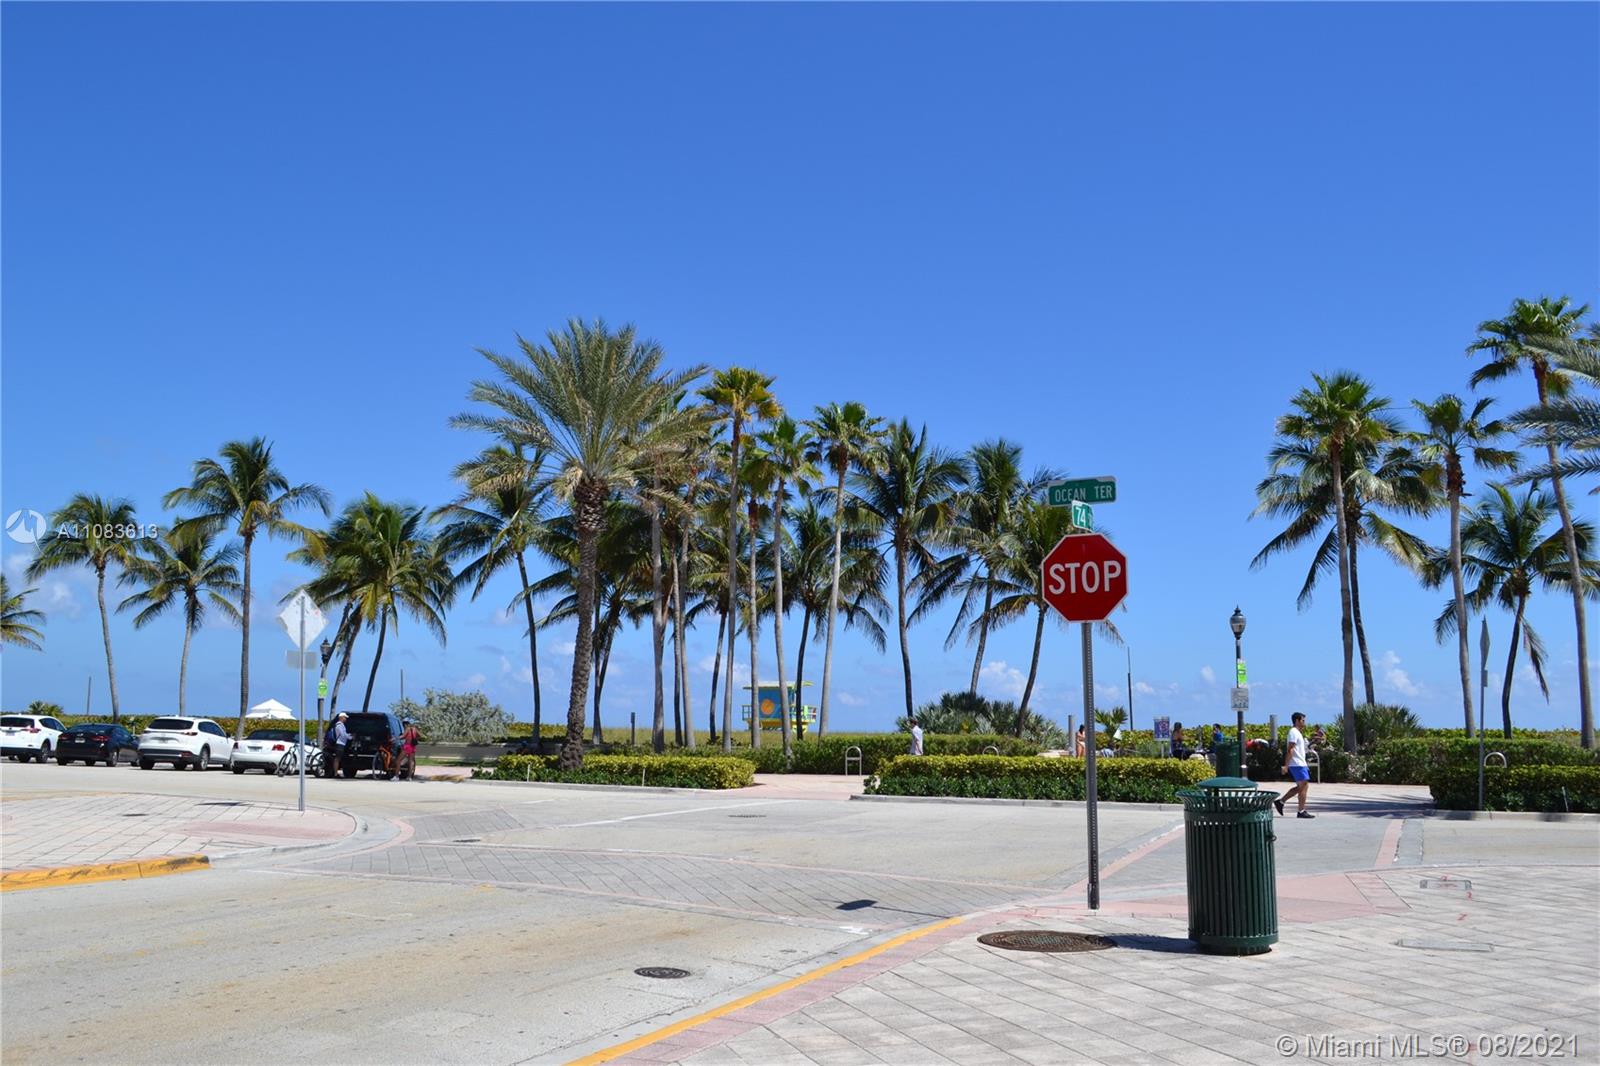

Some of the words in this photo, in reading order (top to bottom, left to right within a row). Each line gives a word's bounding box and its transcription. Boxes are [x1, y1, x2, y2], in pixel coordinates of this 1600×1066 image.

[1055, 488, 1086, 502] OCEAN
[1094, 485, 1113, 499] TER
[1075, 506, 1086, 527] 74
[1048, 560, 1121, 595] STOP
